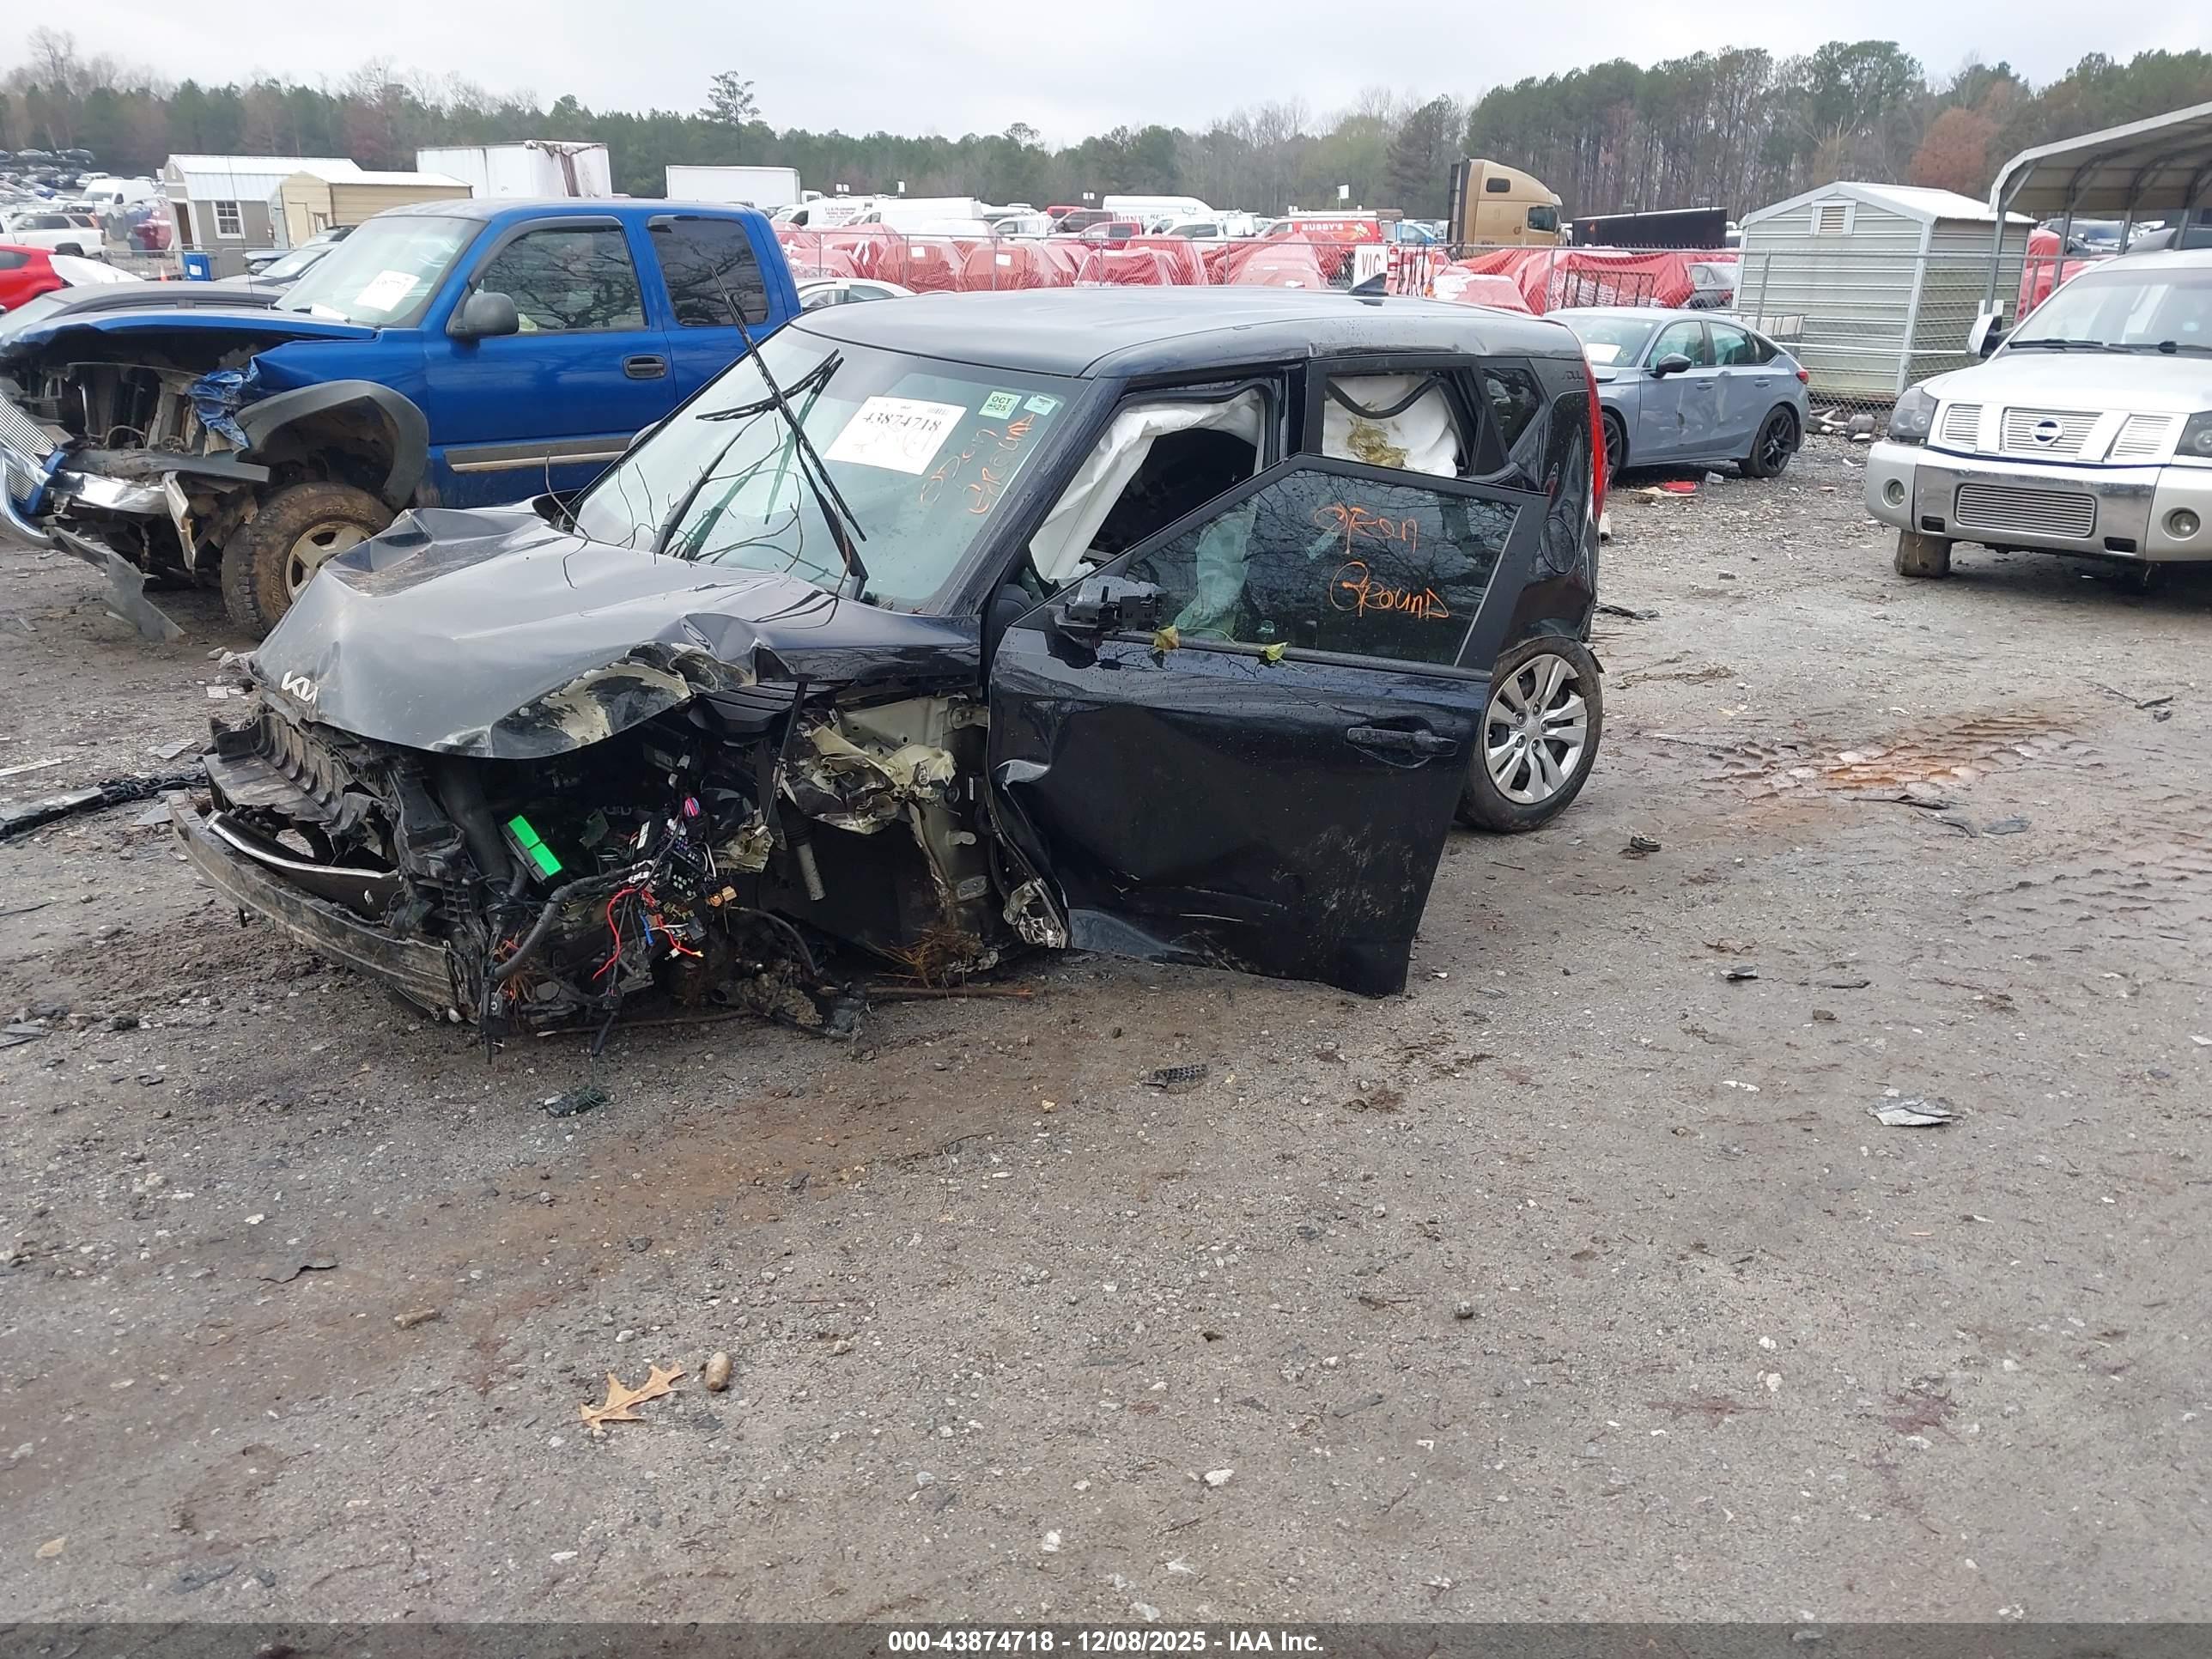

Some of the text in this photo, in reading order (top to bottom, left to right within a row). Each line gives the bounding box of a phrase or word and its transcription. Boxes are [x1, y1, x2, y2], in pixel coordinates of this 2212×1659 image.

[991, 396, 1012, 404] OCT
[863, 412, 941, 431] 43874718
[281, 671, 319, 704] KIA
